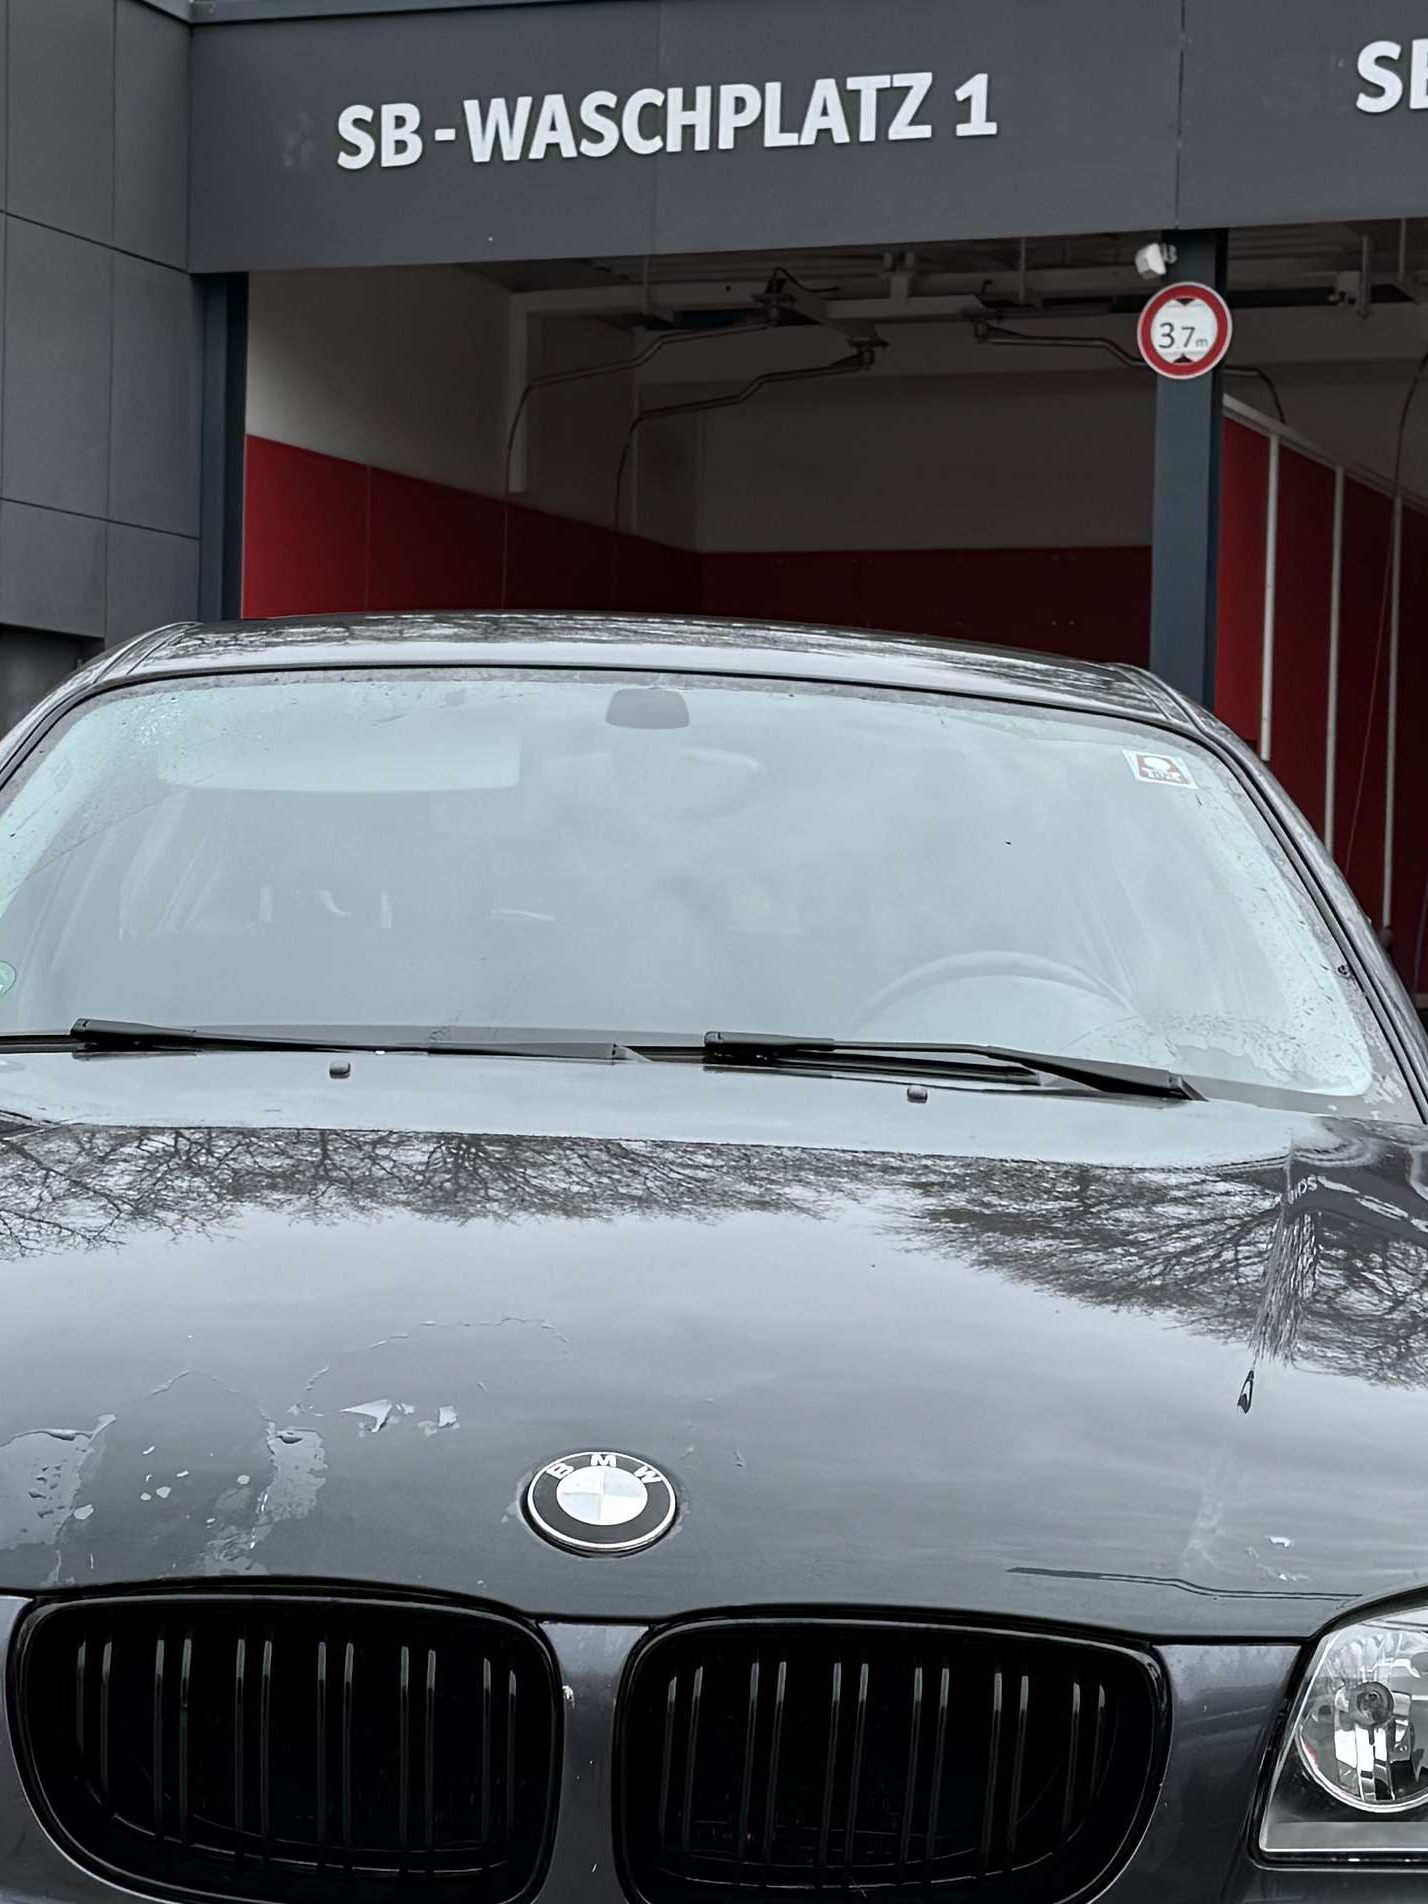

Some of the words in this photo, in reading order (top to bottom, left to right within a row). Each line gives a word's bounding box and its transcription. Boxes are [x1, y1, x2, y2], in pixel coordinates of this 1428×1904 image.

[337, 71, 933, 170] SB-WASCHPLATZ
[954, 73, 998, 137] 1
[546, 1454, 662, 1484] BMW
